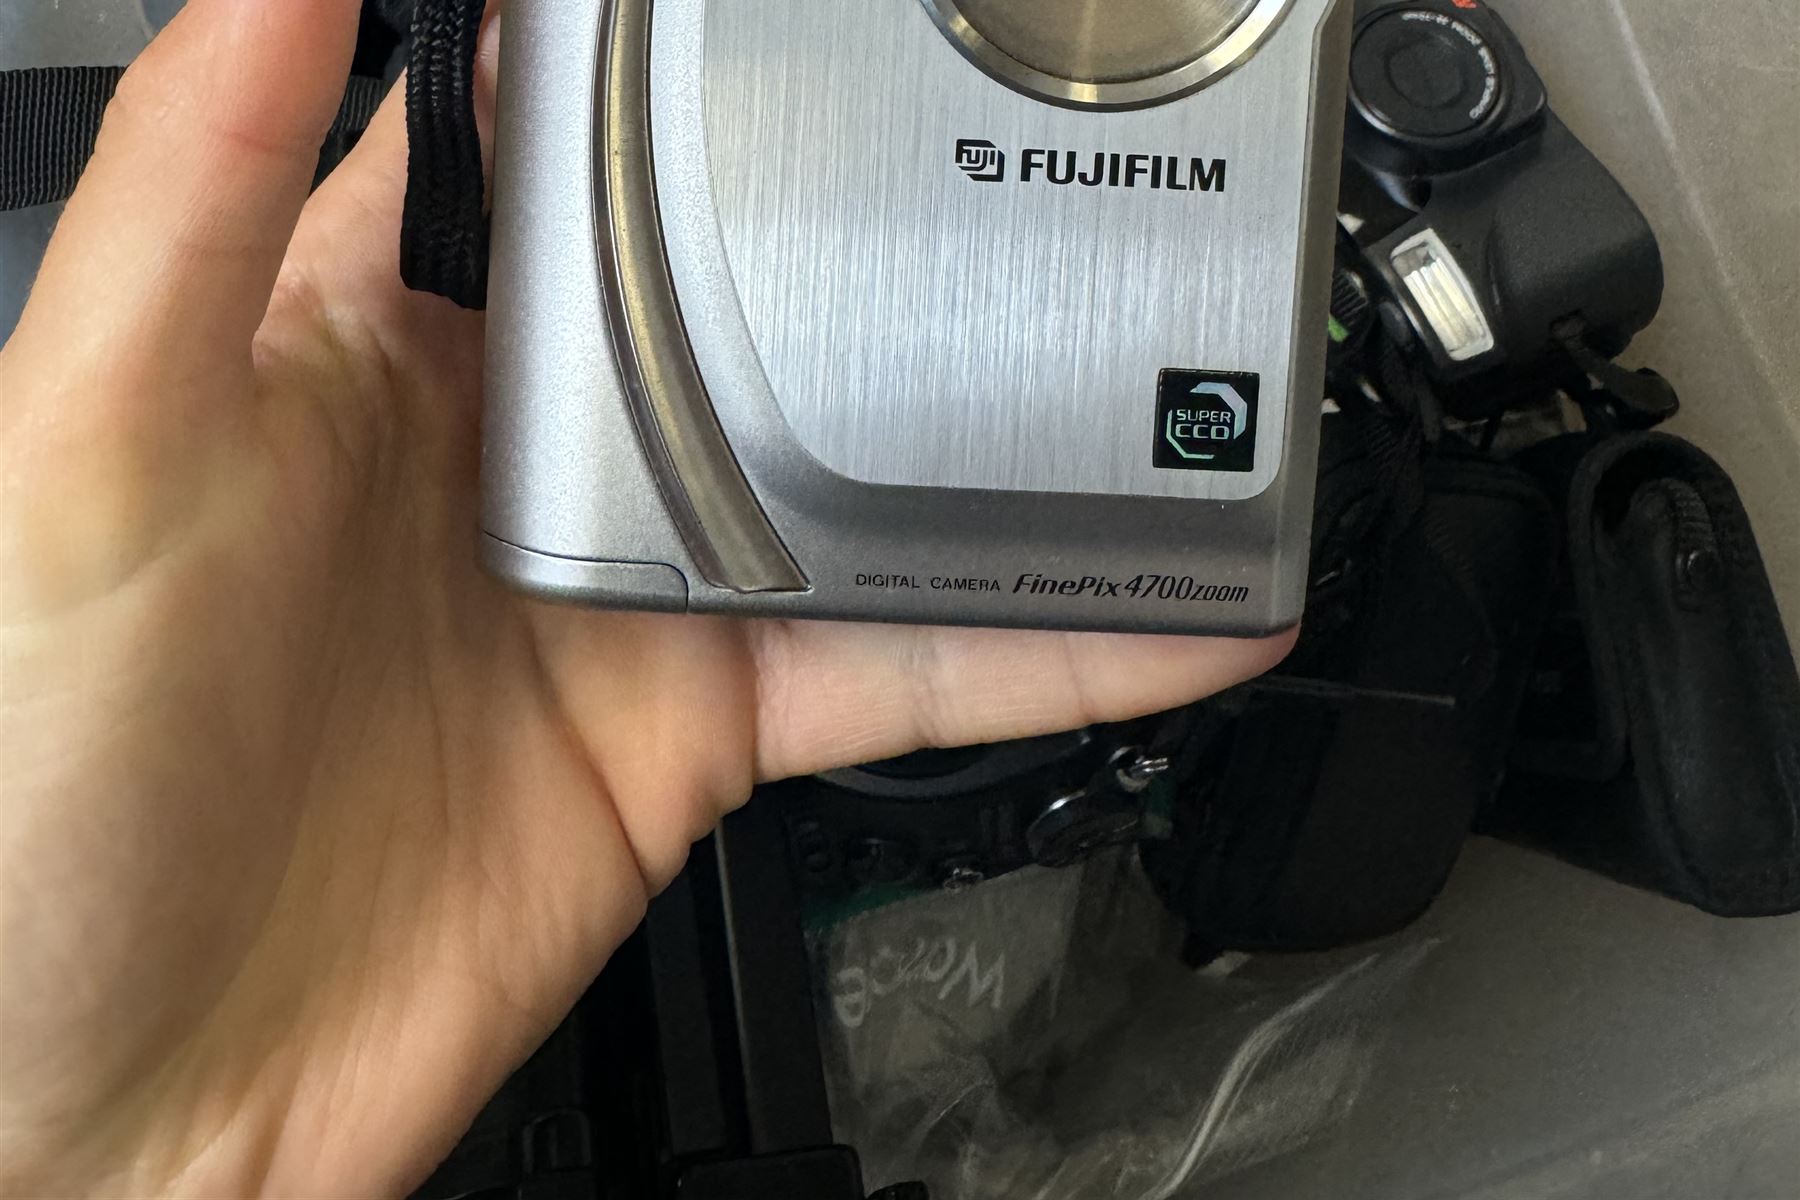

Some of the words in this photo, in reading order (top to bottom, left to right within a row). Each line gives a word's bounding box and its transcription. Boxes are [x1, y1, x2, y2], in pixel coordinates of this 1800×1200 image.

[1020, 149, 1226, 192] FUJIFILM
[1176, 409, 1231, 424] SUPER
[1175, 424, 1230, 440] CCD
[855, 573, 920, 589] DIGITAL
[930, 576, 1001, 592] CAMERA
[1012, 573, 1120, 598] FinePix
